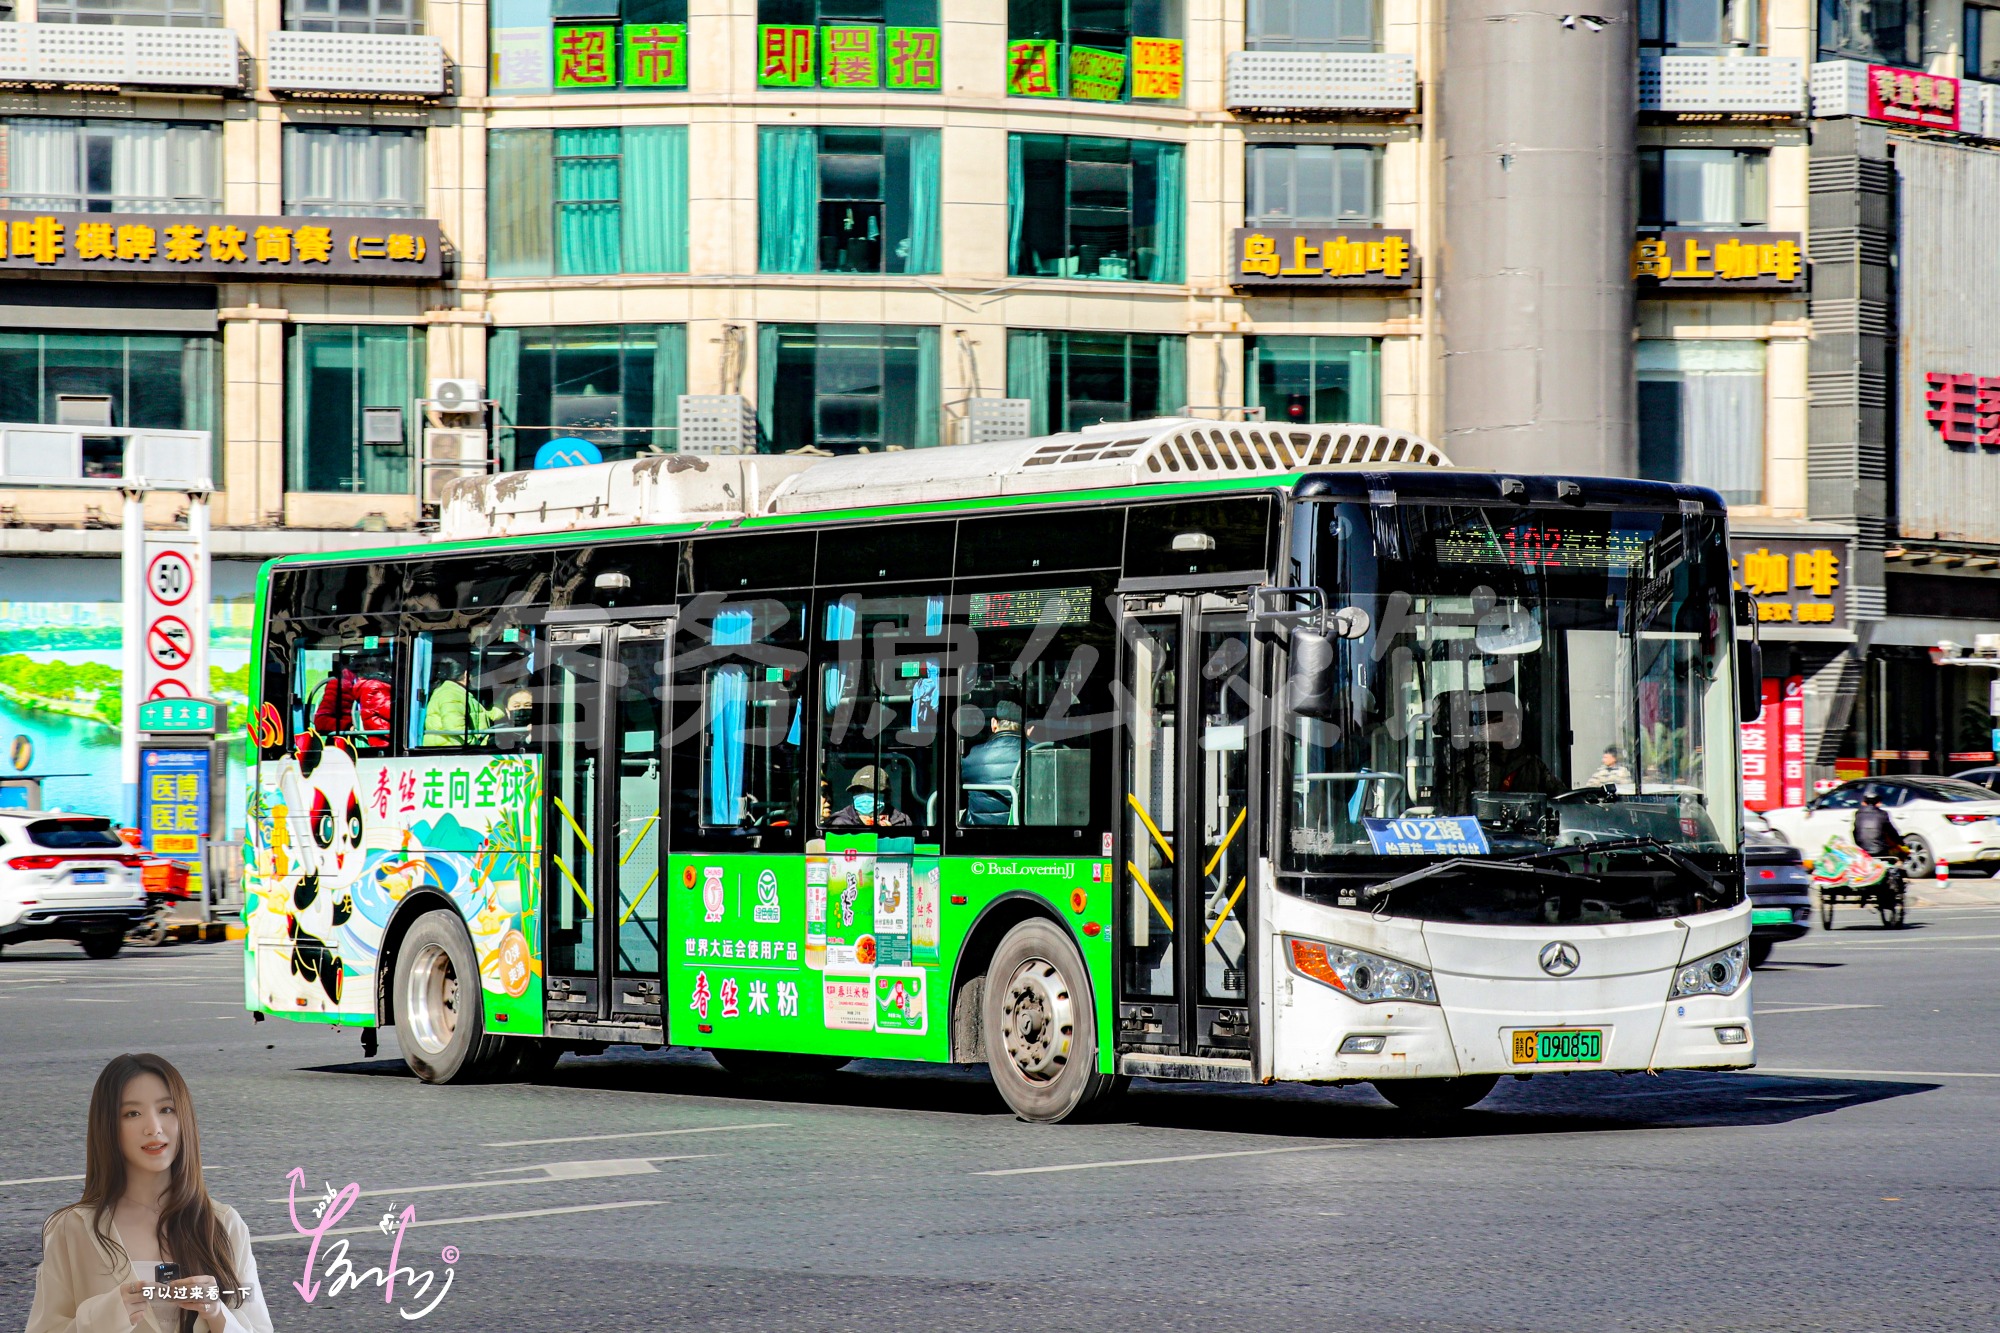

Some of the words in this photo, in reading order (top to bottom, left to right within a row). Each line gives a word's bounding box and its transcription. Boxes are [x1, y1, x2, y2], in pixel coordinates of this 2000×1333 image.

[765, 28, 809, 83] 即
[829, 28, 873, 84] 四楼
[892, 29, 935, 85] 招
[1010, 43, 1052, 94] 租
[1241, 233, 1409, 277] 岛上咖啡
[1631, 237, 1802, 281] 岛上咖啡
[1505, 527, 1561, 566] 102
[159, 564, 180, 593] 50
[370, 766, 525, 819] 春丝走向全球
[151, 803, 199, 831] 医院
[1386, 820, 1465, 841] 102路
[685, 938, 798, 960] 世界大运会使用产品
[689, 971, 799, 1019] 春丝米粉
